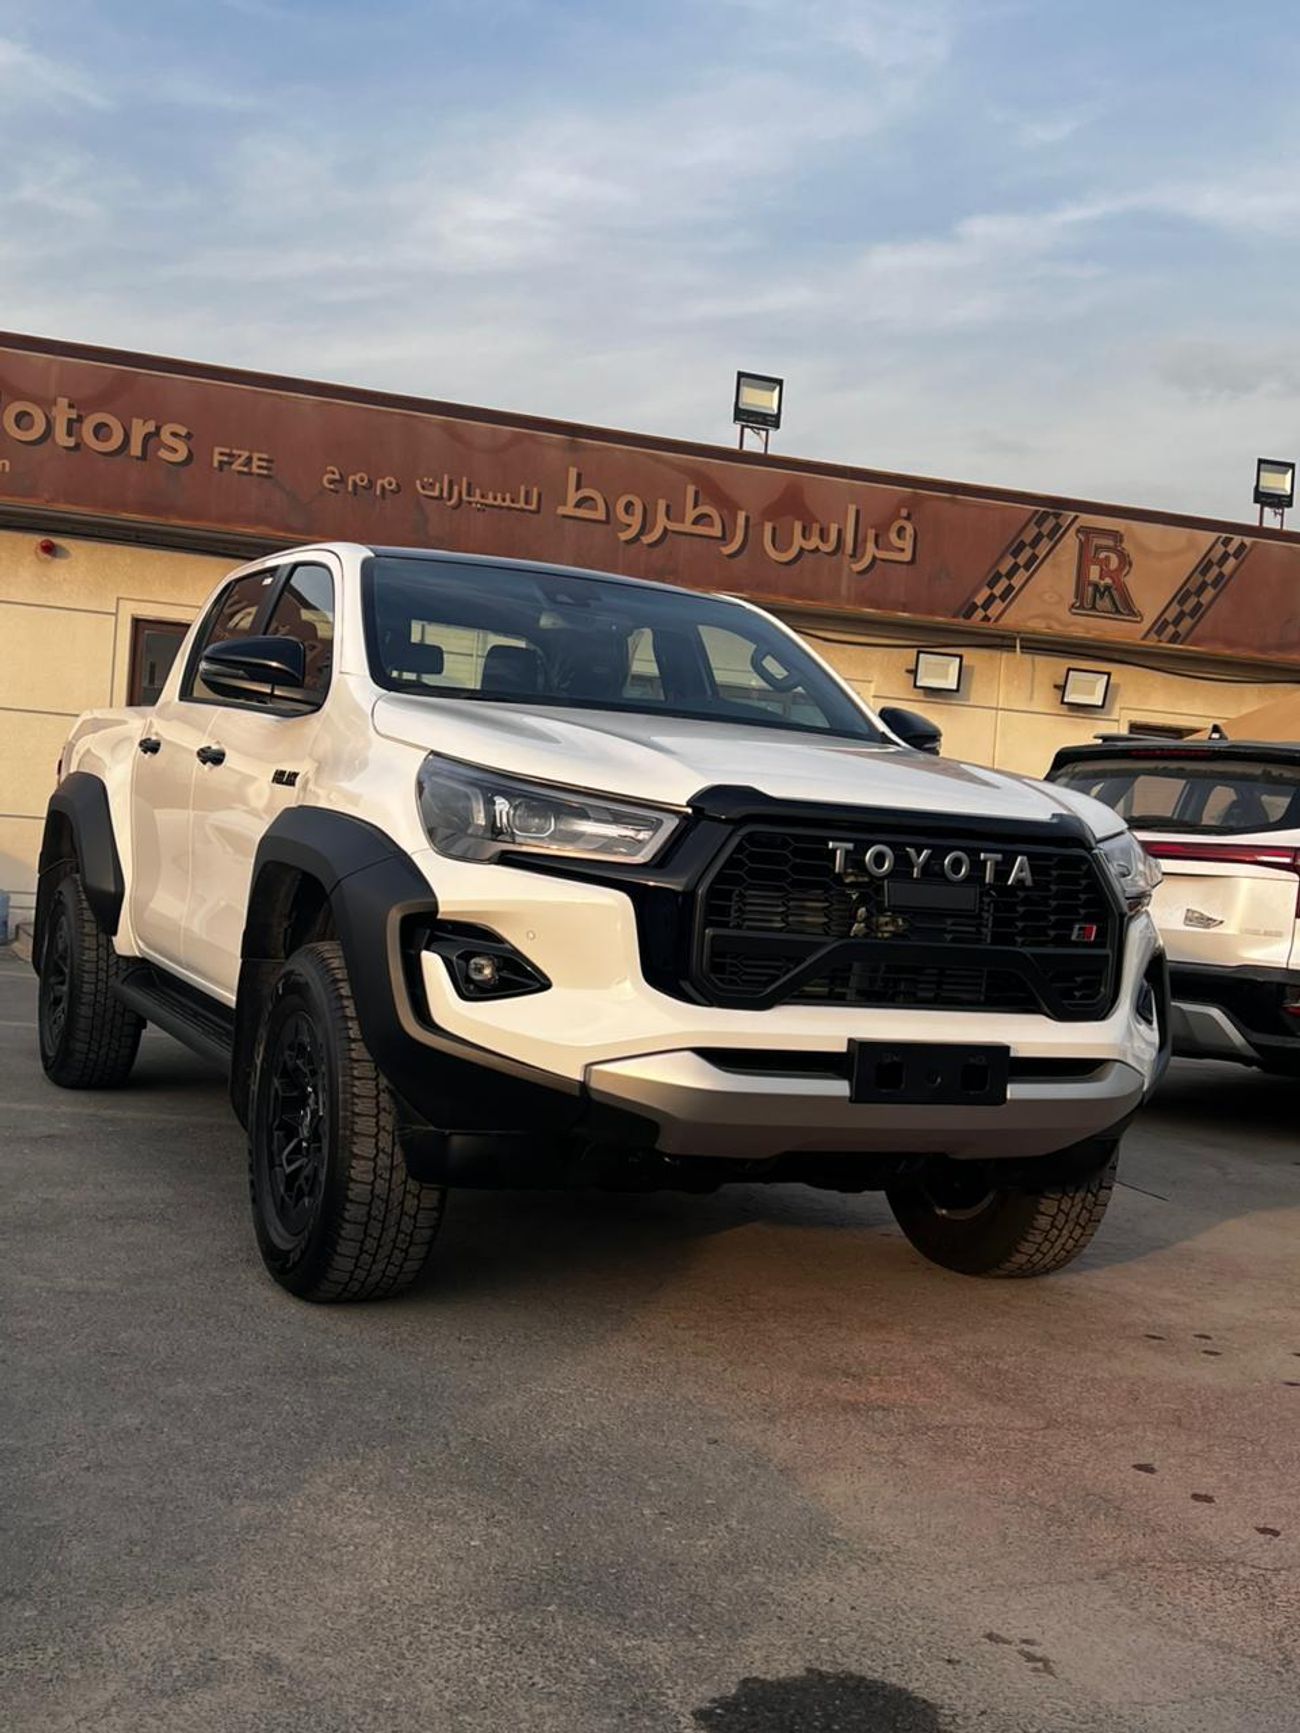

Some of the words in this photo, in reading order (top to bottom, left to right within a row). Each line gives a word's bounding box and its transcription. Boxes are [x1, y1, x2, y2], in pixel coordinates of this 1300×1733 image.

[2, 397, 190, 464] otors
[212, 446, 271, 475] FZE
[415, 474, 539, 510] للسيارات
[556, 466, 747, 555] رطروط
[763, 504, 914, 573] فراس
[828, 841, 1033, 886] TOYOTA
